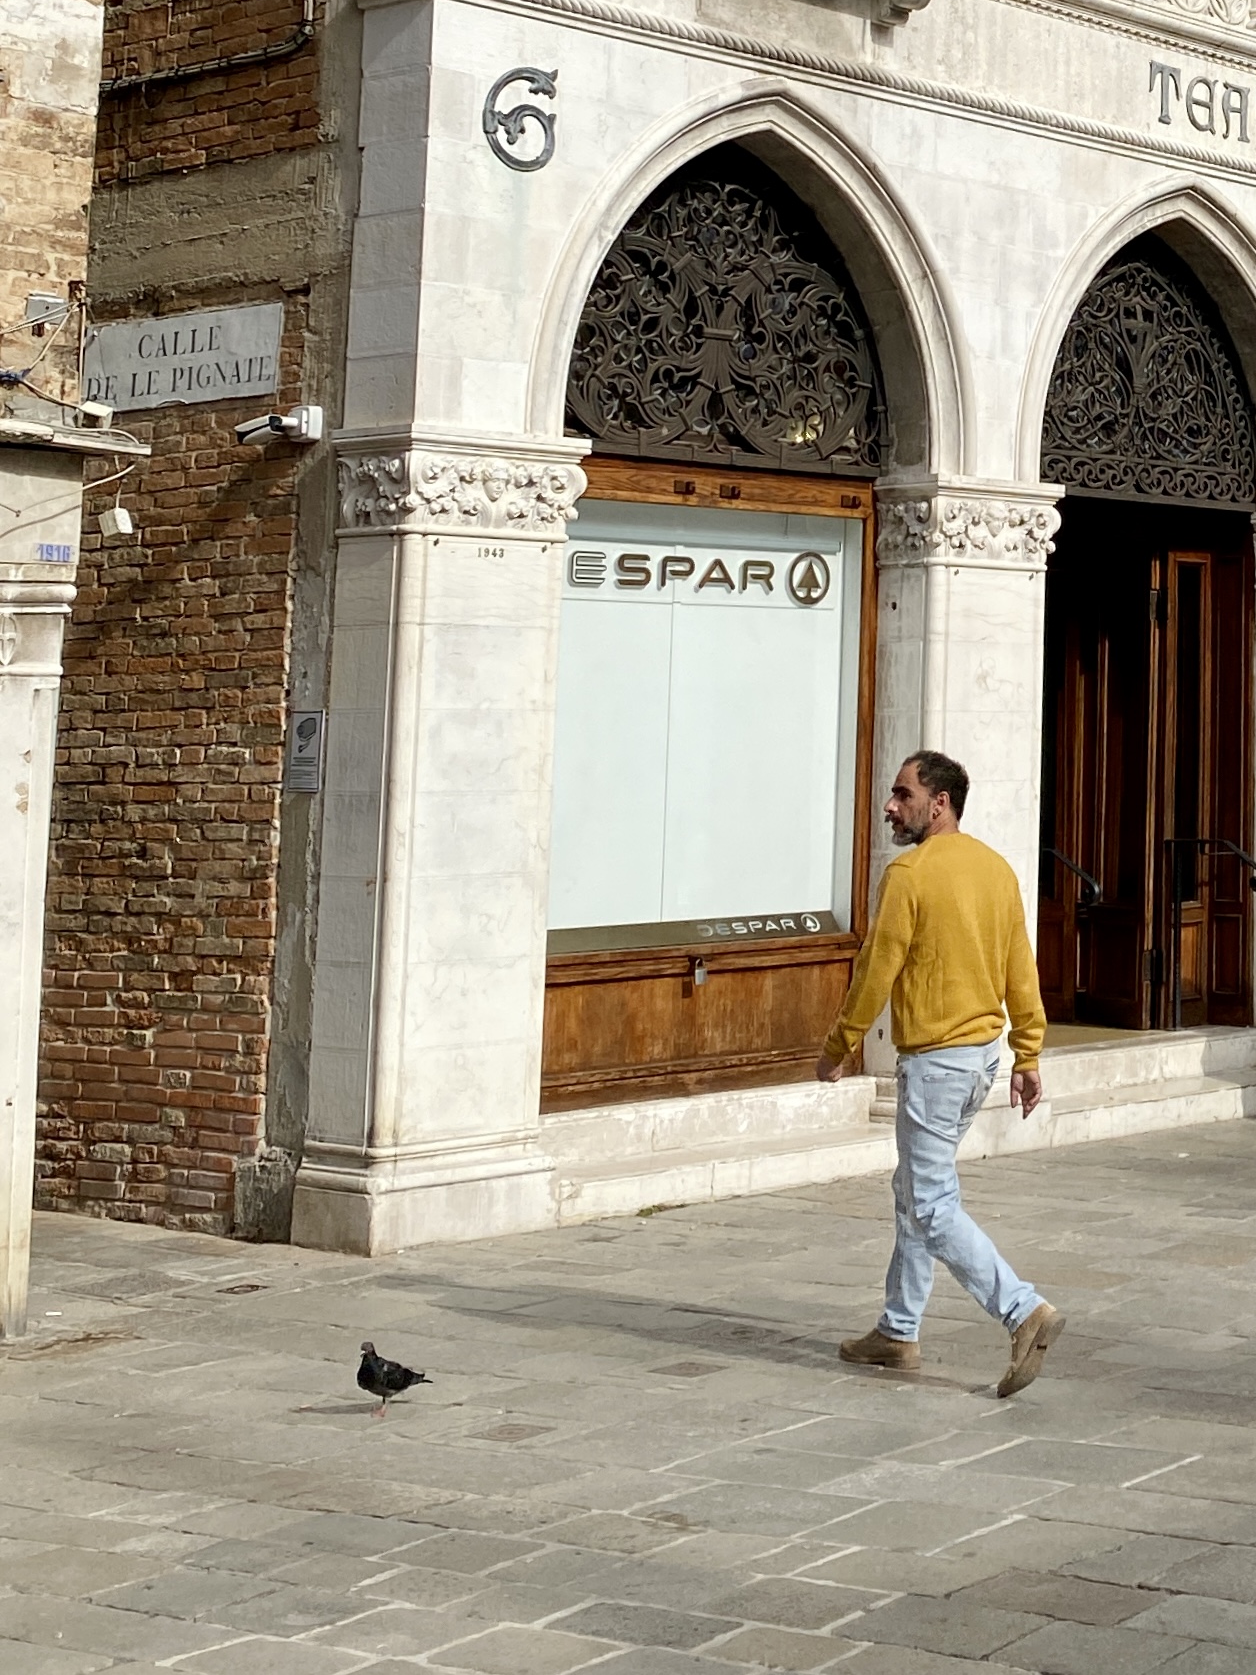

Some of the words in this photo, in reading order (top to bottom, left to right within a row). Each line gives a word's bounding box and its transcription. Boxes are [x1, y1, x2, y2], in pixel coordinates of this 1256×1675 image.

[138, 325, 222, 359] CALLE
[86, 374, 118, 402] DE
[131, 370, 160, 397] LE
[171, 355, 272, 392] PIGNATE
[477, 547, 505, 559] 1943
[697, 918, 797, 937] DESPAR
